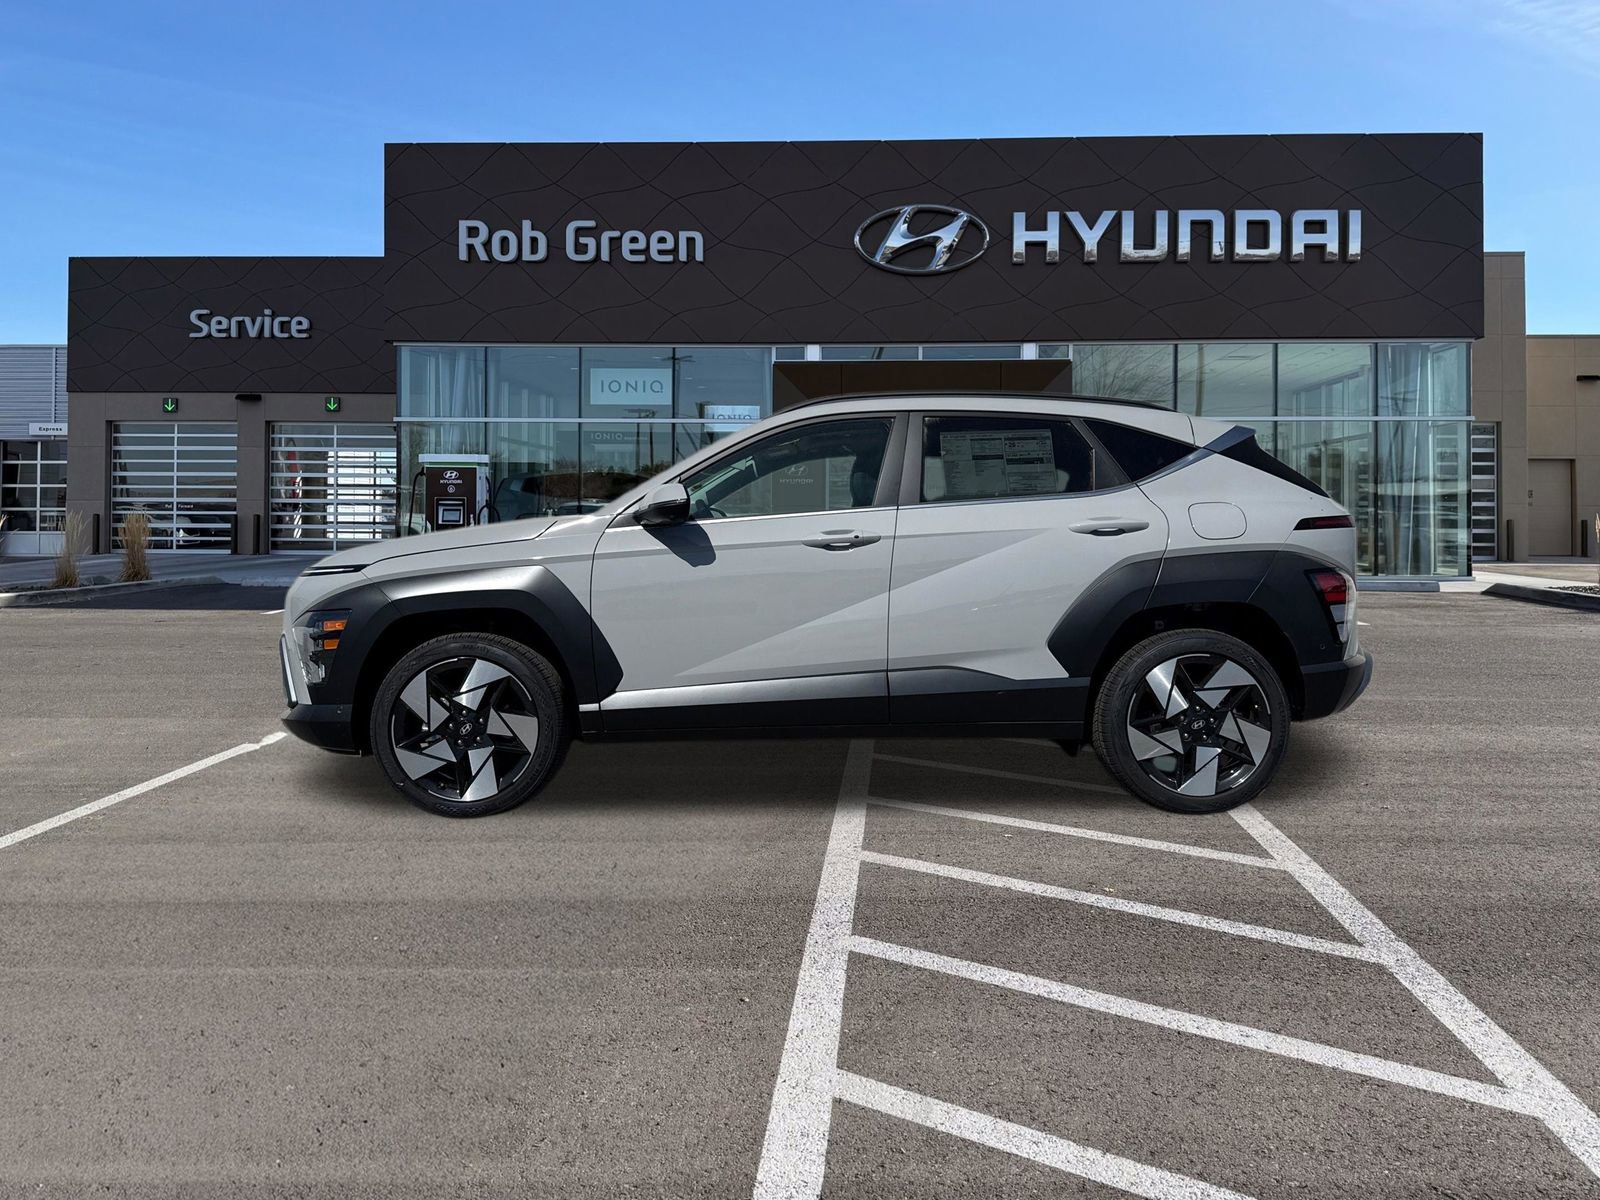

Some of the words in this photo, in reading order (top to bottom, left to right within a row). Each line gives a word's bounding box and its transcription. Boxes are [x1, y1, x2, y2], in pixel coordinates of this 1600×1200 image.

[458, 219, 548, 262] Rob
[565, 219, 704, 263] Green
[1011, 209, 1362, 263] HYUNDAI
[189, 308, 311, 338] Service
[601, 379, 664, 394] IONIQ
